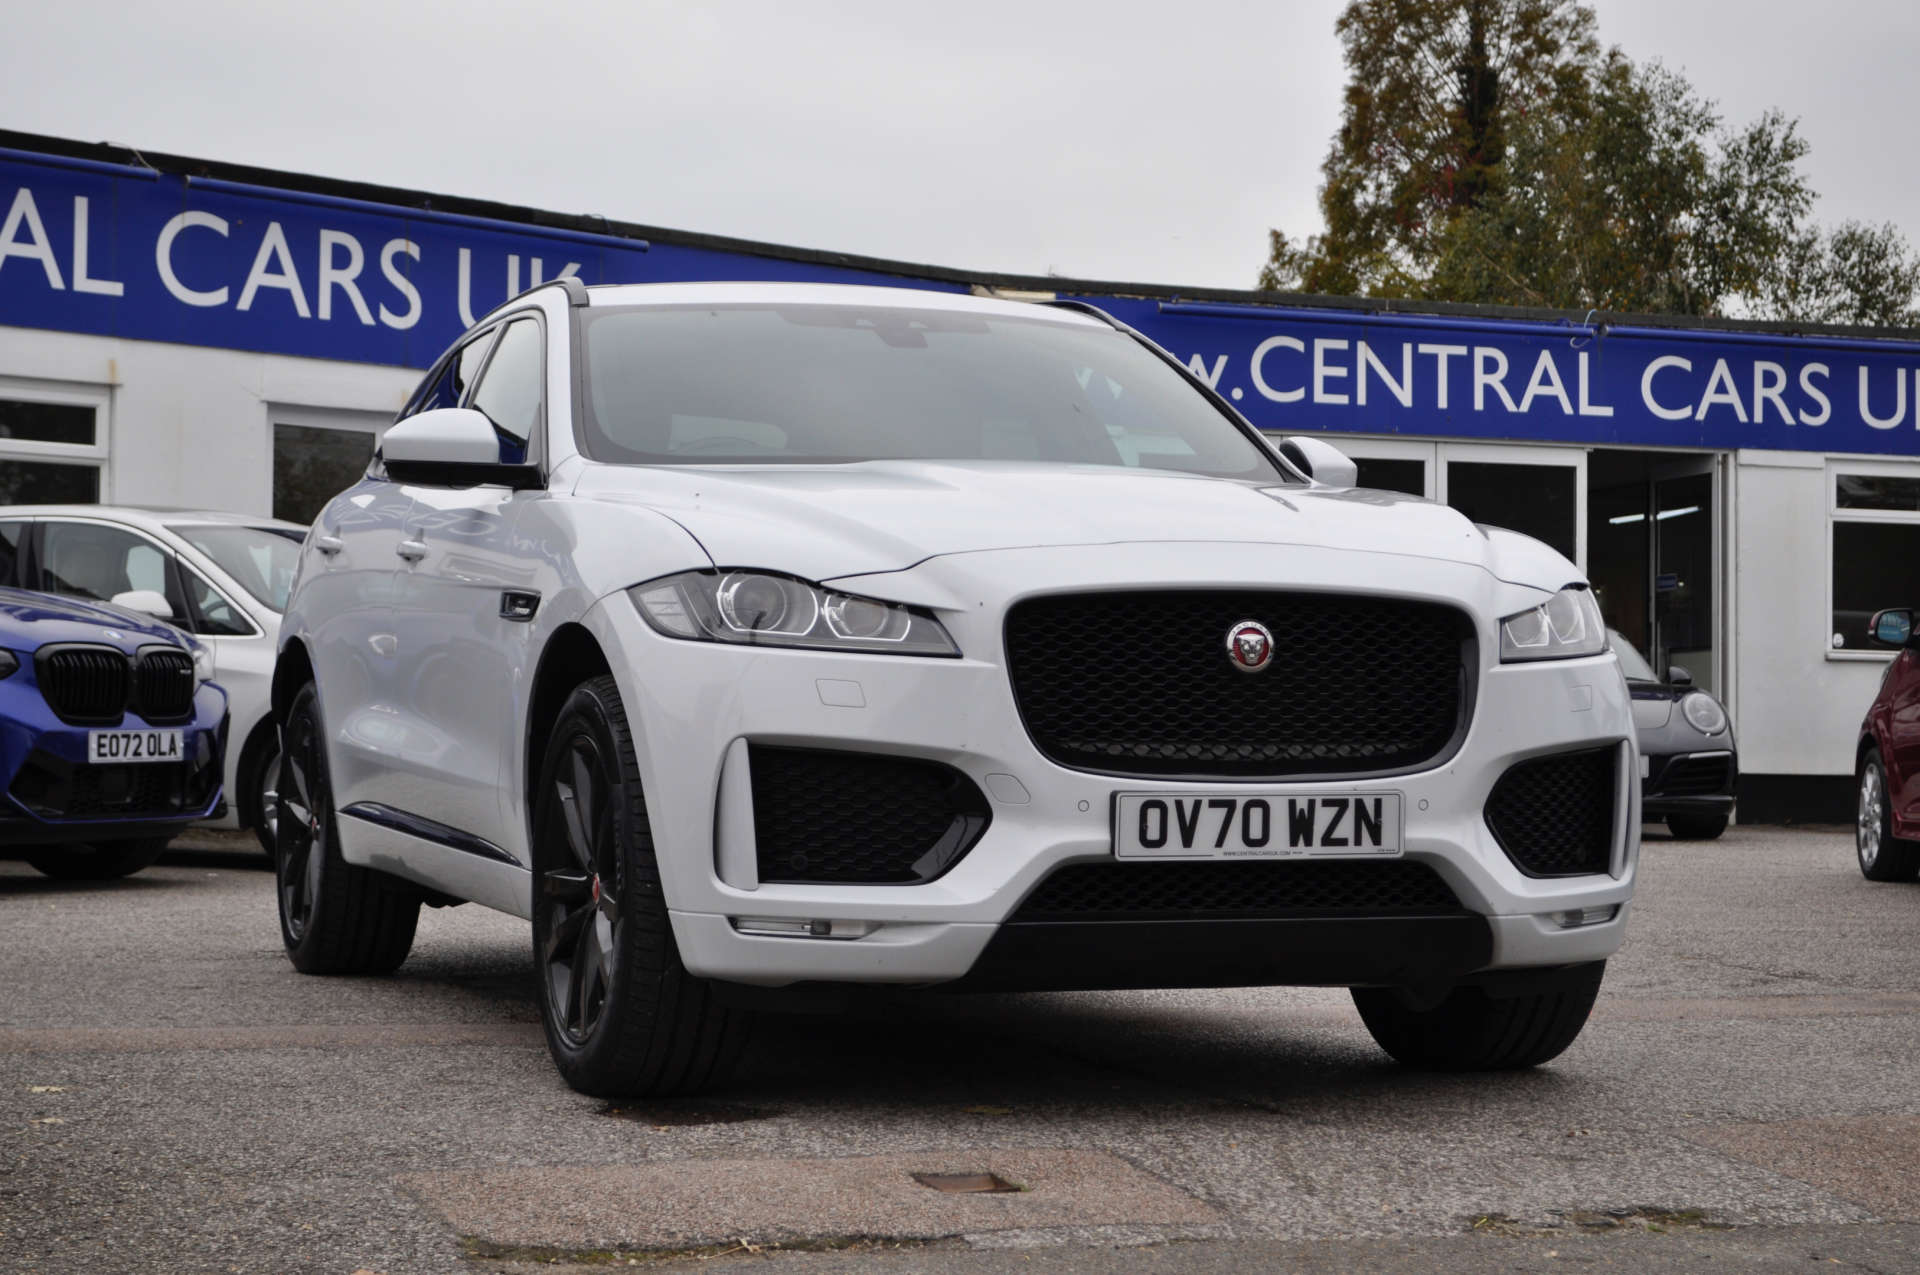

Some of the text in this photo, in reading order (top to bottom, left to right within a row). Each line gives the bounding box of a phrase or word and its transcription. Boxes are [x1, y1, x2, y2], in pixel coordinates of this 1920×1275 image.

[0, 188, 123, 297] AL
[156, 210, 422, 330] CARS
[1641, 355, 1832, 427] CARS
[1858, 365, 1920, 431] U
[147, 733, 177, 756] OLA
[1138, 797, 1383, 849] OV70 WZN
